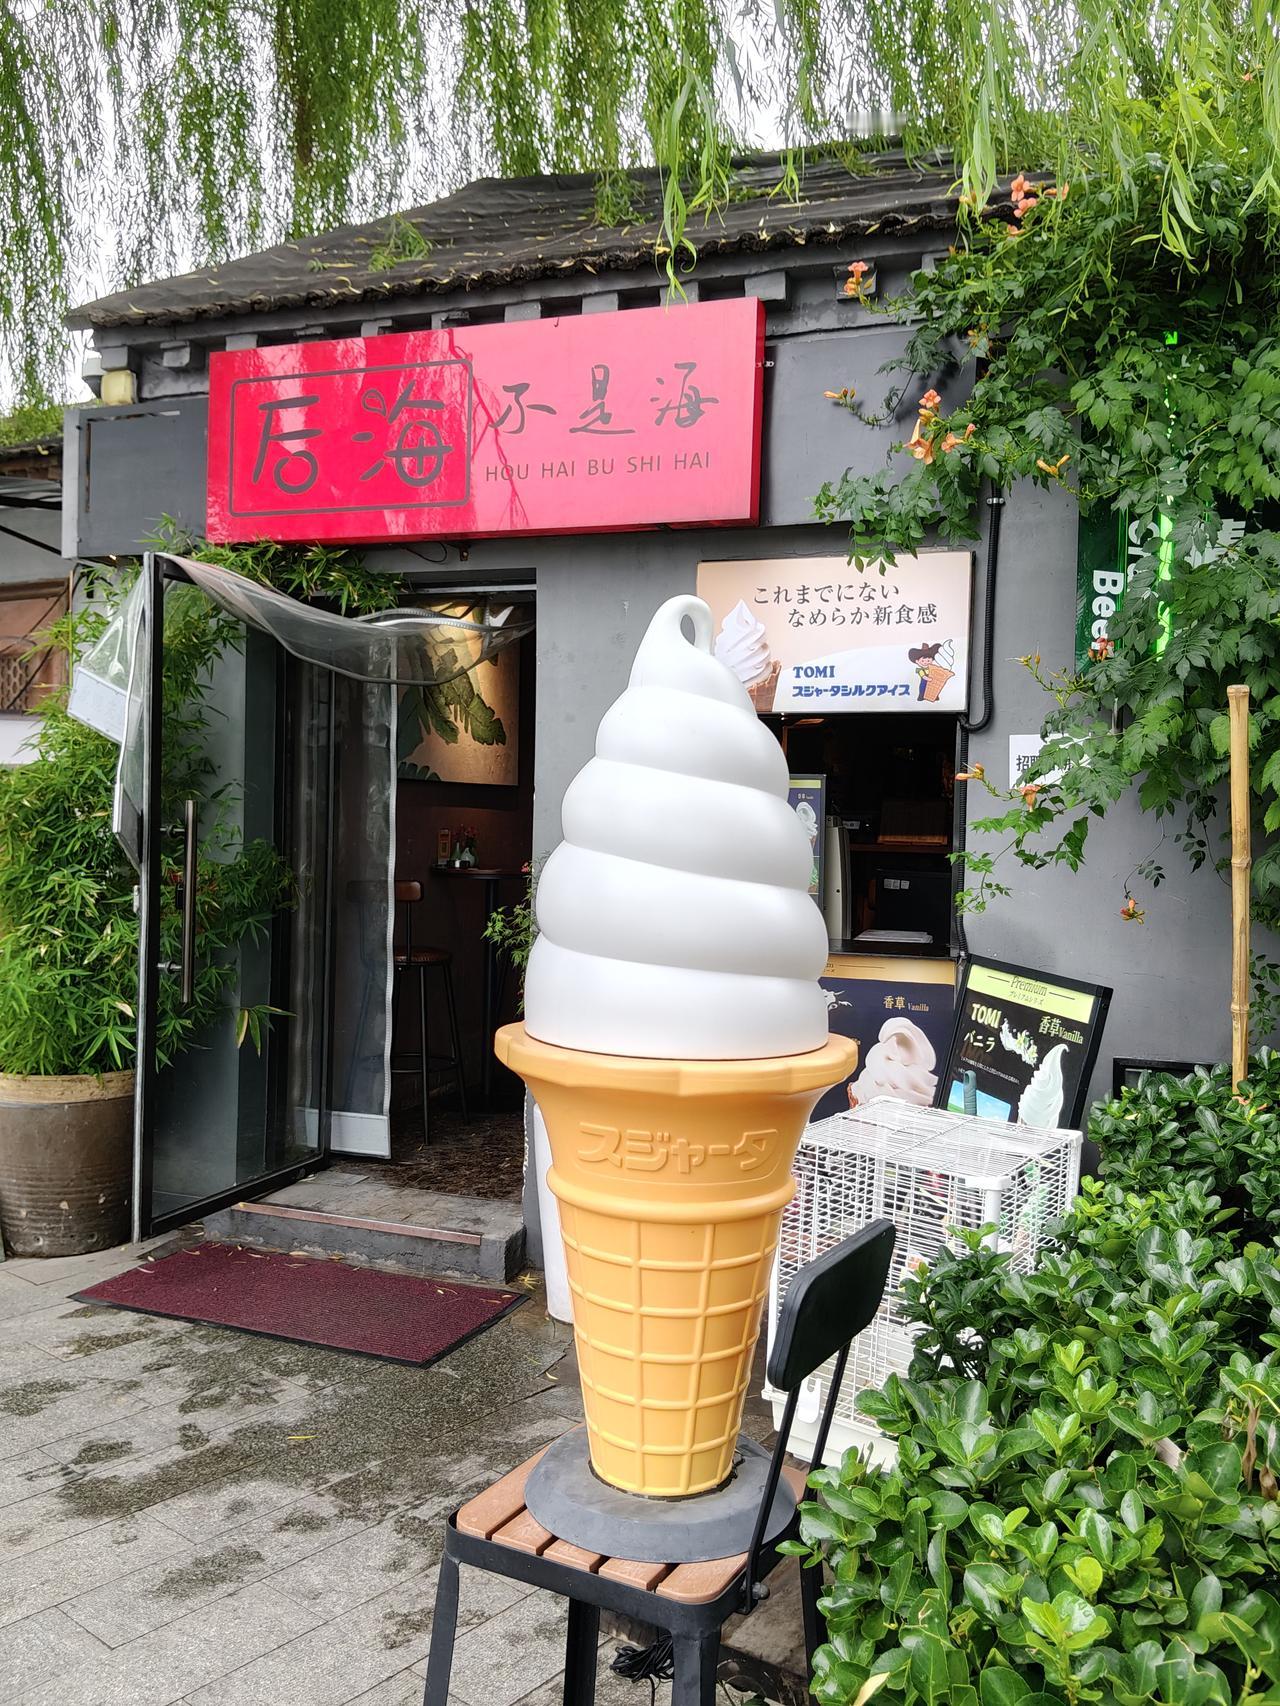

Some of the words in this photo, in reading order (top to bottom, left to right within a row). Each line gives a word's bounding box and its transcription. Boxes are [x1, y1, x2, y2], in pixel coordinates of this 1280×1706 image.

[252, 378, 454, 494] 后海
[487, 362, 719, 436] 不是海
[485, 463, 530, 482] HOU
[541, 460, 576, 479] HAI
[587, 458, 615, 476] BU
[626, 455, 661, 473] SHI
[674, 451, 710, 470] HAI
[753, 581, 900, 605] これまでにない
[787, 603, 938, 628] なめらか新食感
[792, 665, 836, 680] TOMI
[791, 684, 911, 698] スジャータシルクアイス
[1010, 975, 1048, 997] Premium
[883, 995, 906, 1010] 香草
[970, 1003, 1002, 1029] TOMI
[963, 1030, 996, 1053] バニラ
[1038, 1015, 1061, 1037] 香草
[1058, 1028, 1083, 1045] Vanilla
[577, 1121, 778, 1175] スジャータ
